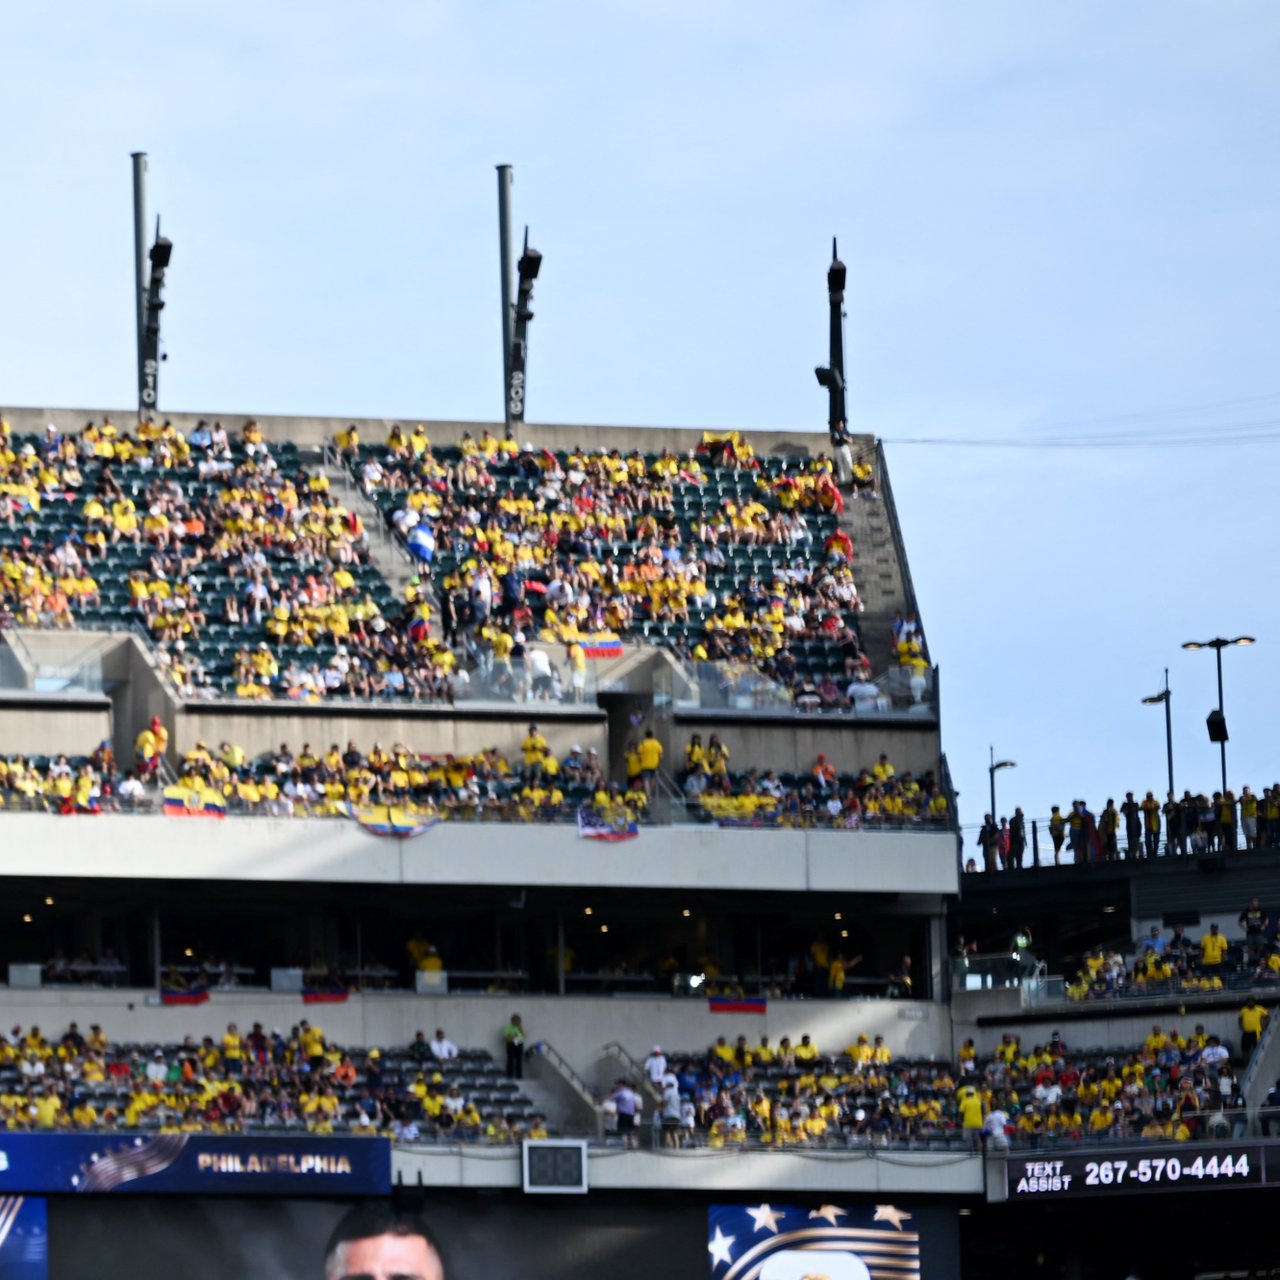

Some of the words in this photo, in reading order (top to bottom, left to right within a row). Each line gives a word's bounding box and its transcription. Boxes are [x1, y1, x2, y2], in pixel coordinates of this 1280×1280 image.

[198, 1152, 352, 1174] PHILADELPHIA
[1025, 1161, 1064, 1177] TEXT
[1085, 1154, 1250, 1185] 267-570-4444
[1017, 1175, 1072, 1193] ASSIST
